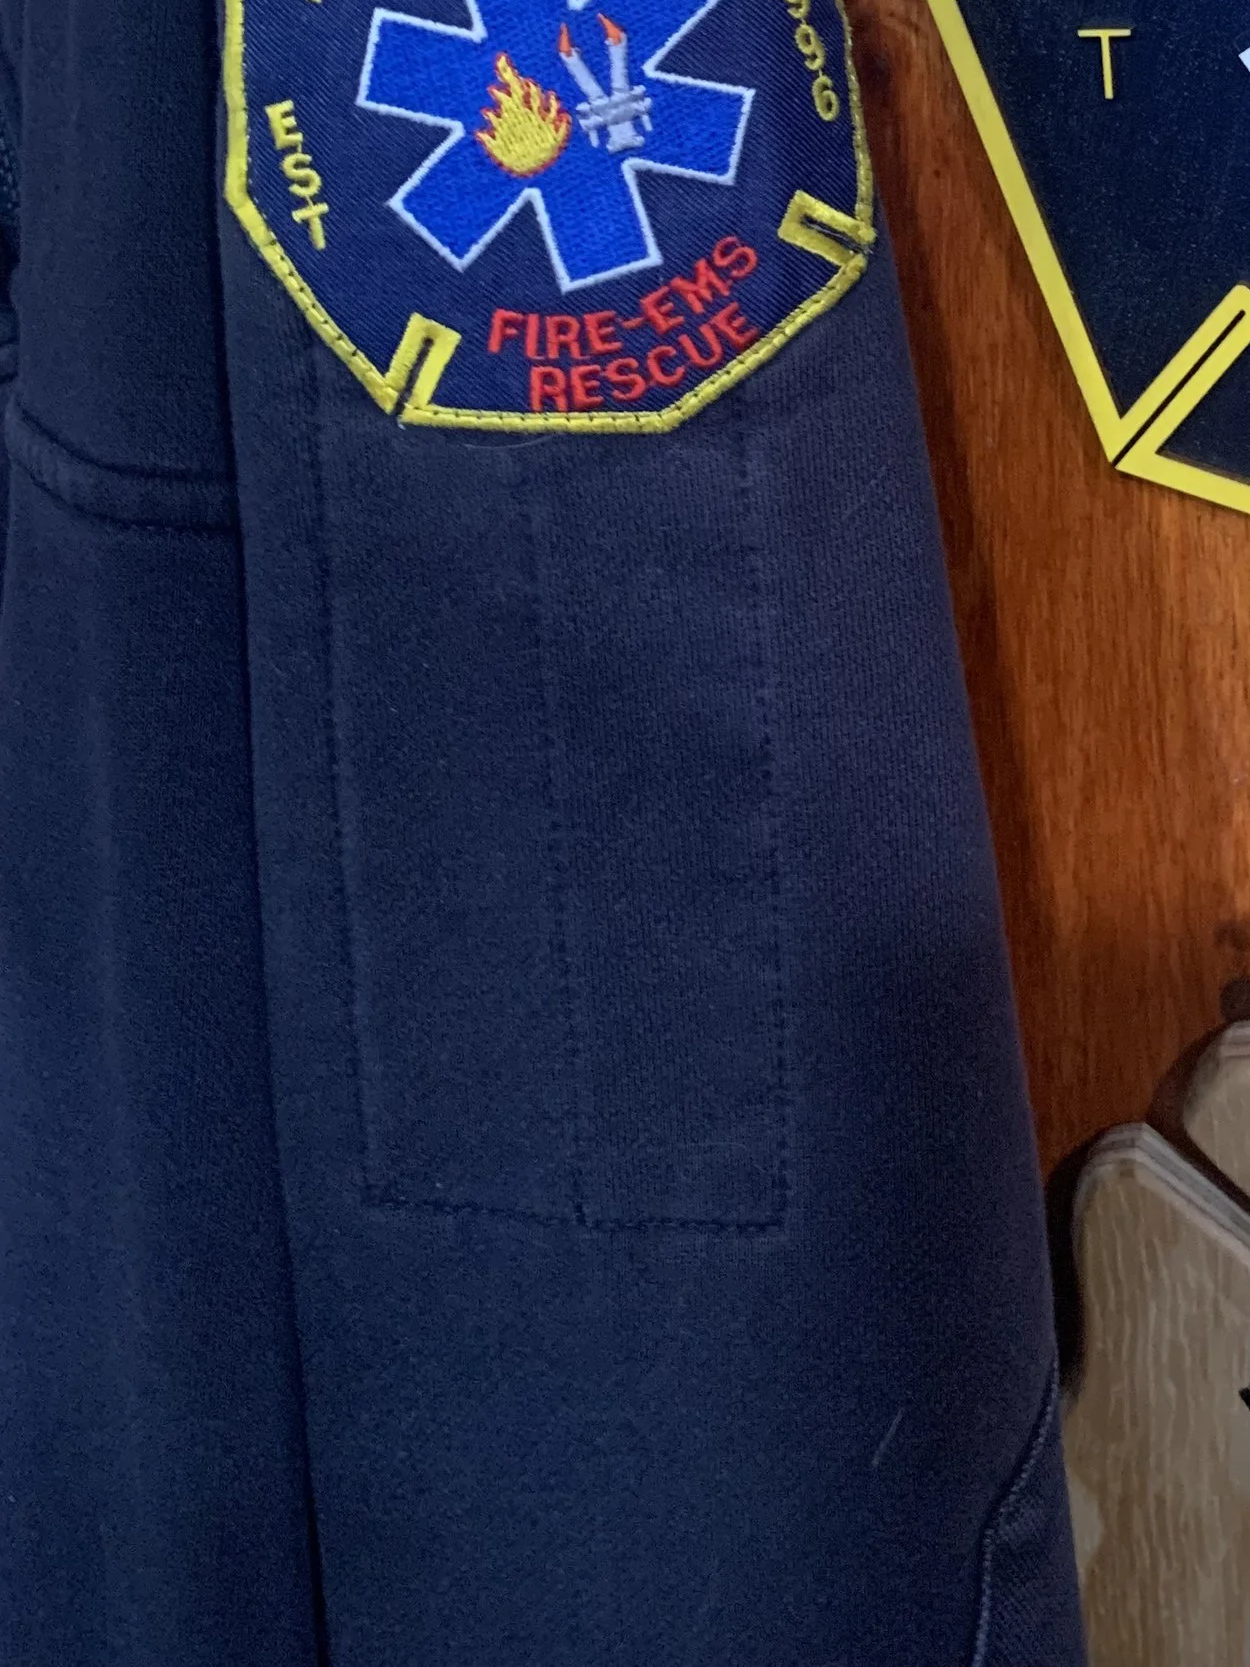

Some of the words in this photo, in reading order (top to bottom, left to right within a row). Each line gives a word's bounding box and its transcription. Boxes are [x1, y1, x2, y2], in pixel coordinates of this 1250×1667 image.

[265, 100, 328, 250] EST
[487, 235, 759, 361] FIRE-EMS
[530, 302, 759, 413] RESCUE
